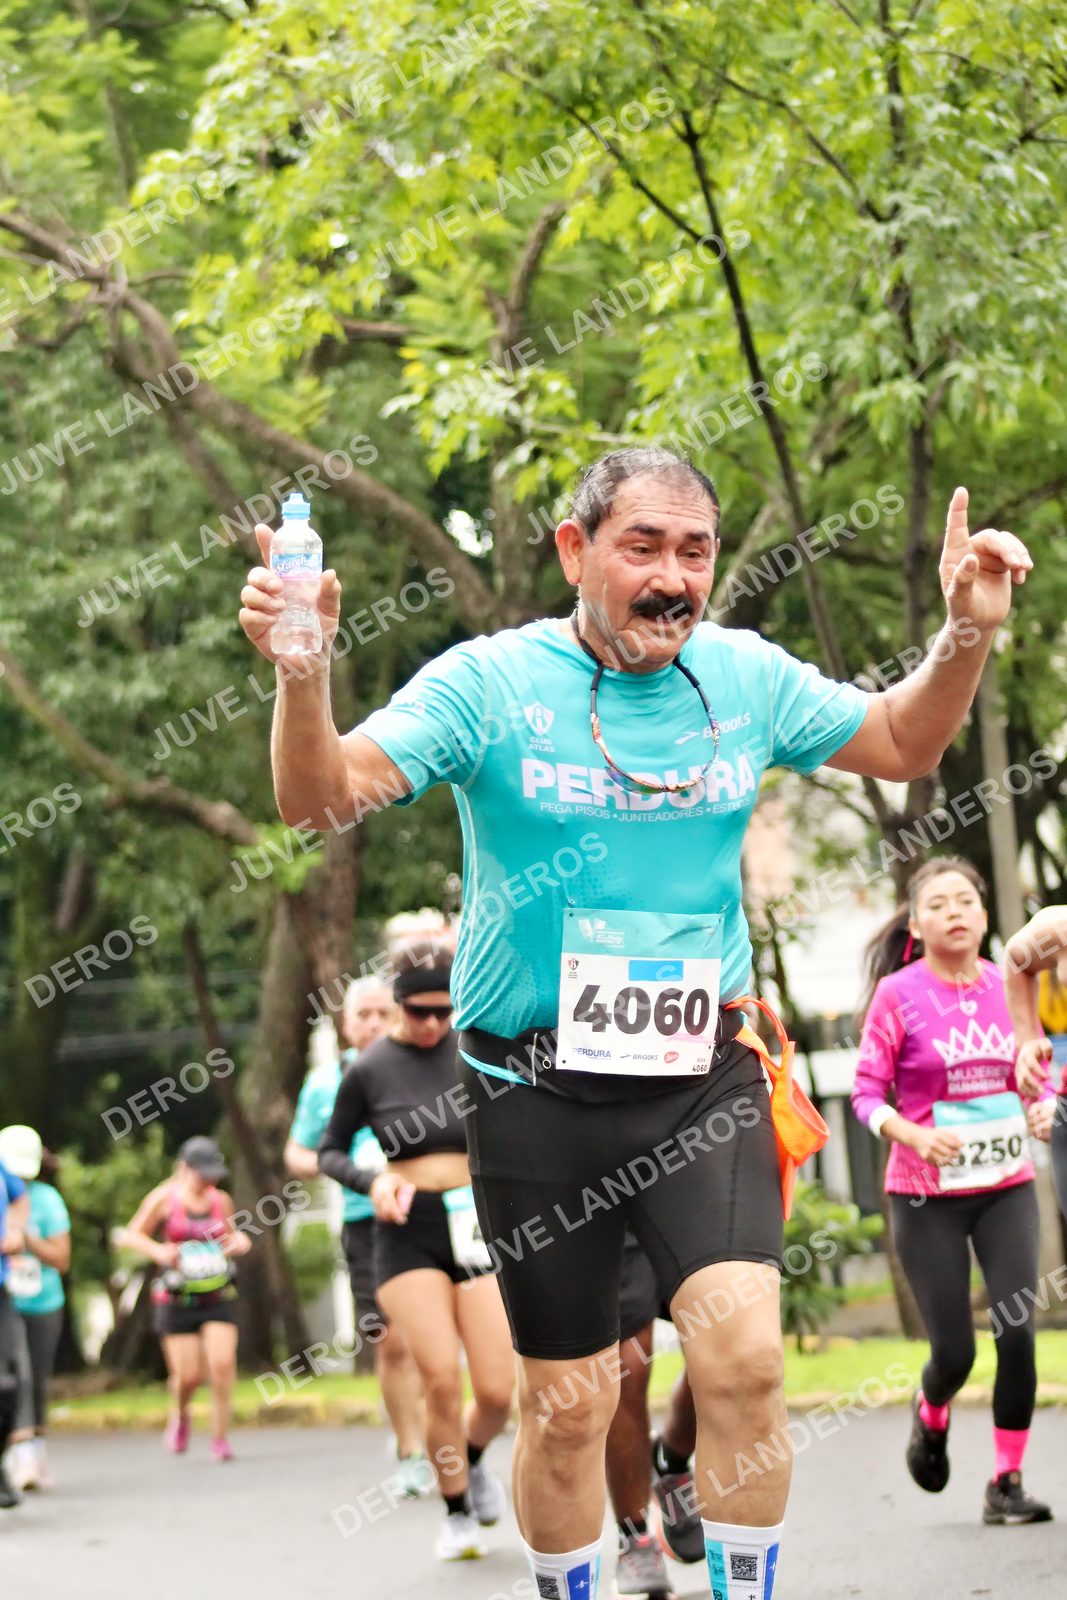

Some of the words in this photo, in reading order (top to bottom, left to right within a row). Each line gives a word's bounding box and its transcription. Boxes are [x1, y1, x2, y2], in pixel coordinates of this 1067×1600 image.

[521, 754, 756, 811] PERDURA
[540, 801, 572, 815] PEGA
[576, 805, 610, 819] PISOS
[618, 806, 703, 822] JUNTEADORES
[573, 984, 710, 1036] 4060
[692, 1064, 708, 1073] 4060
